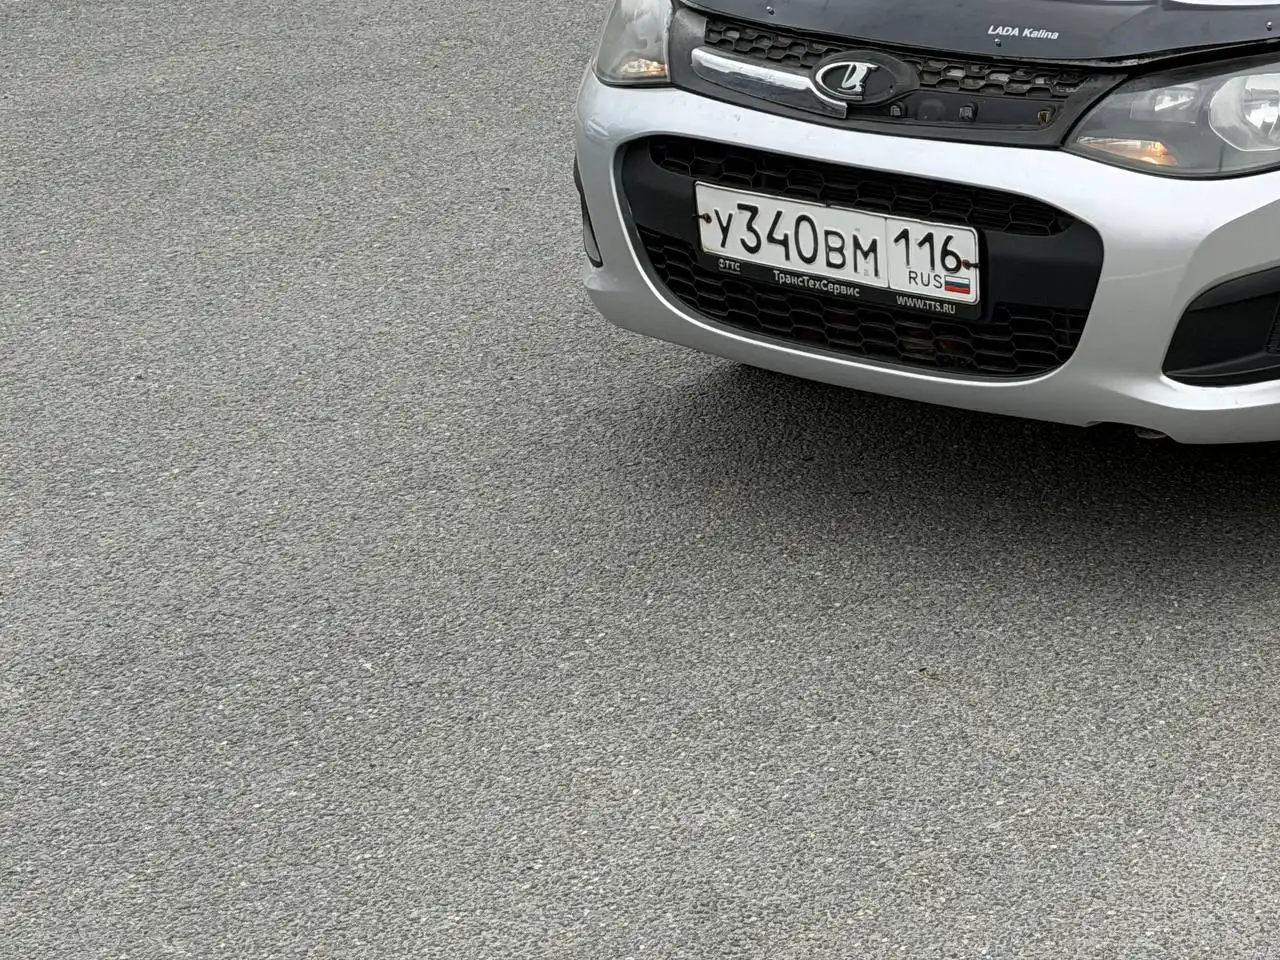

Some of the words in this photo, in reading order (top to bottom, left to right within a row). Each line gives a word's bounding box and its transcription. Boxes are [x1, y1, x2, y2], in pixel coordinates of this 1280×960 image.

[988, 25, 1020, 37] LADA
[1022, 27, 1059, 40] Kalina
[894, 228, 962, 274] 116
[773, 270, 860, 297] ТрансТехСервис
[908, 270, 943, 290] RUS
[896, 295, 956, 314] WWW.TTS.RU
